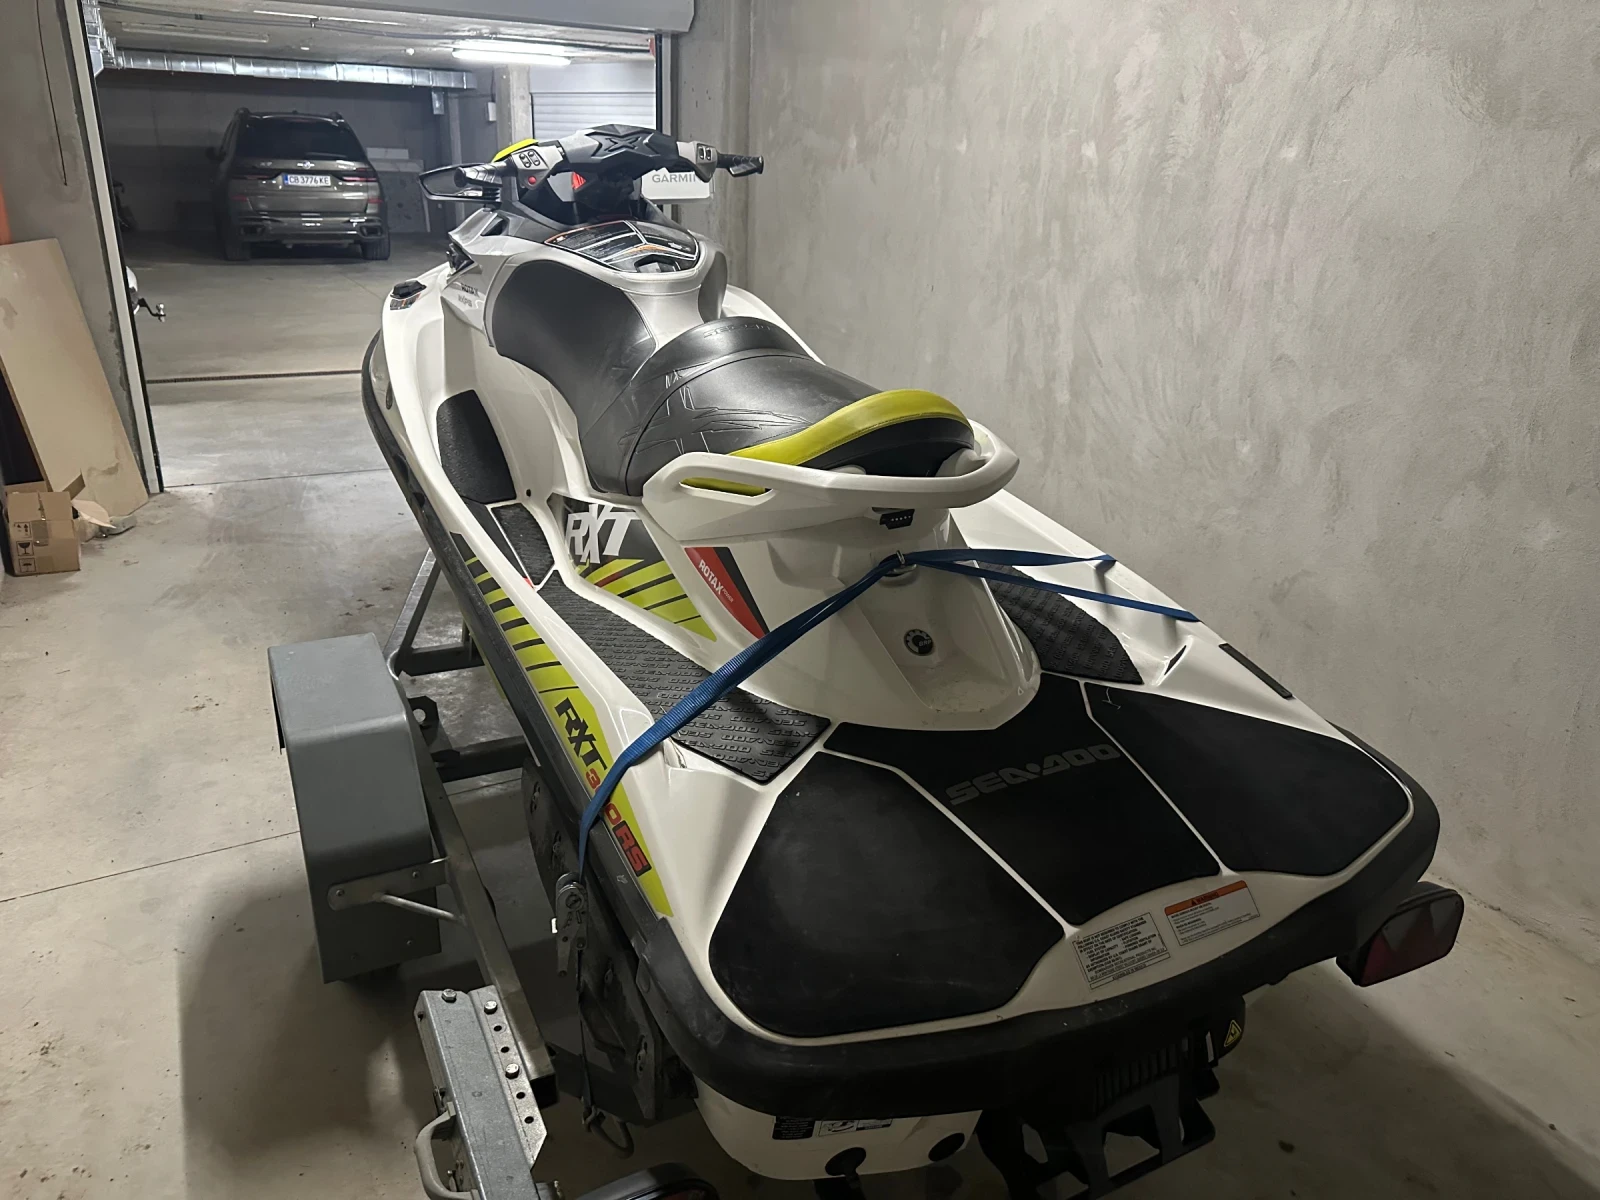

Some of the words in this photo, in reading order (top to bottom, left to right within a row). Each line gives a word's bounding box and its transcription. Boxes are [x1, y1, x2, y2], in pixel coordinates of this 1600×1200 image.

[565, 503, 642, 564] RXT
[698, 559, 724, 595] ROTAX
[554, 697, 607, 771] RXT
[586, 767, 622, 826] 30
